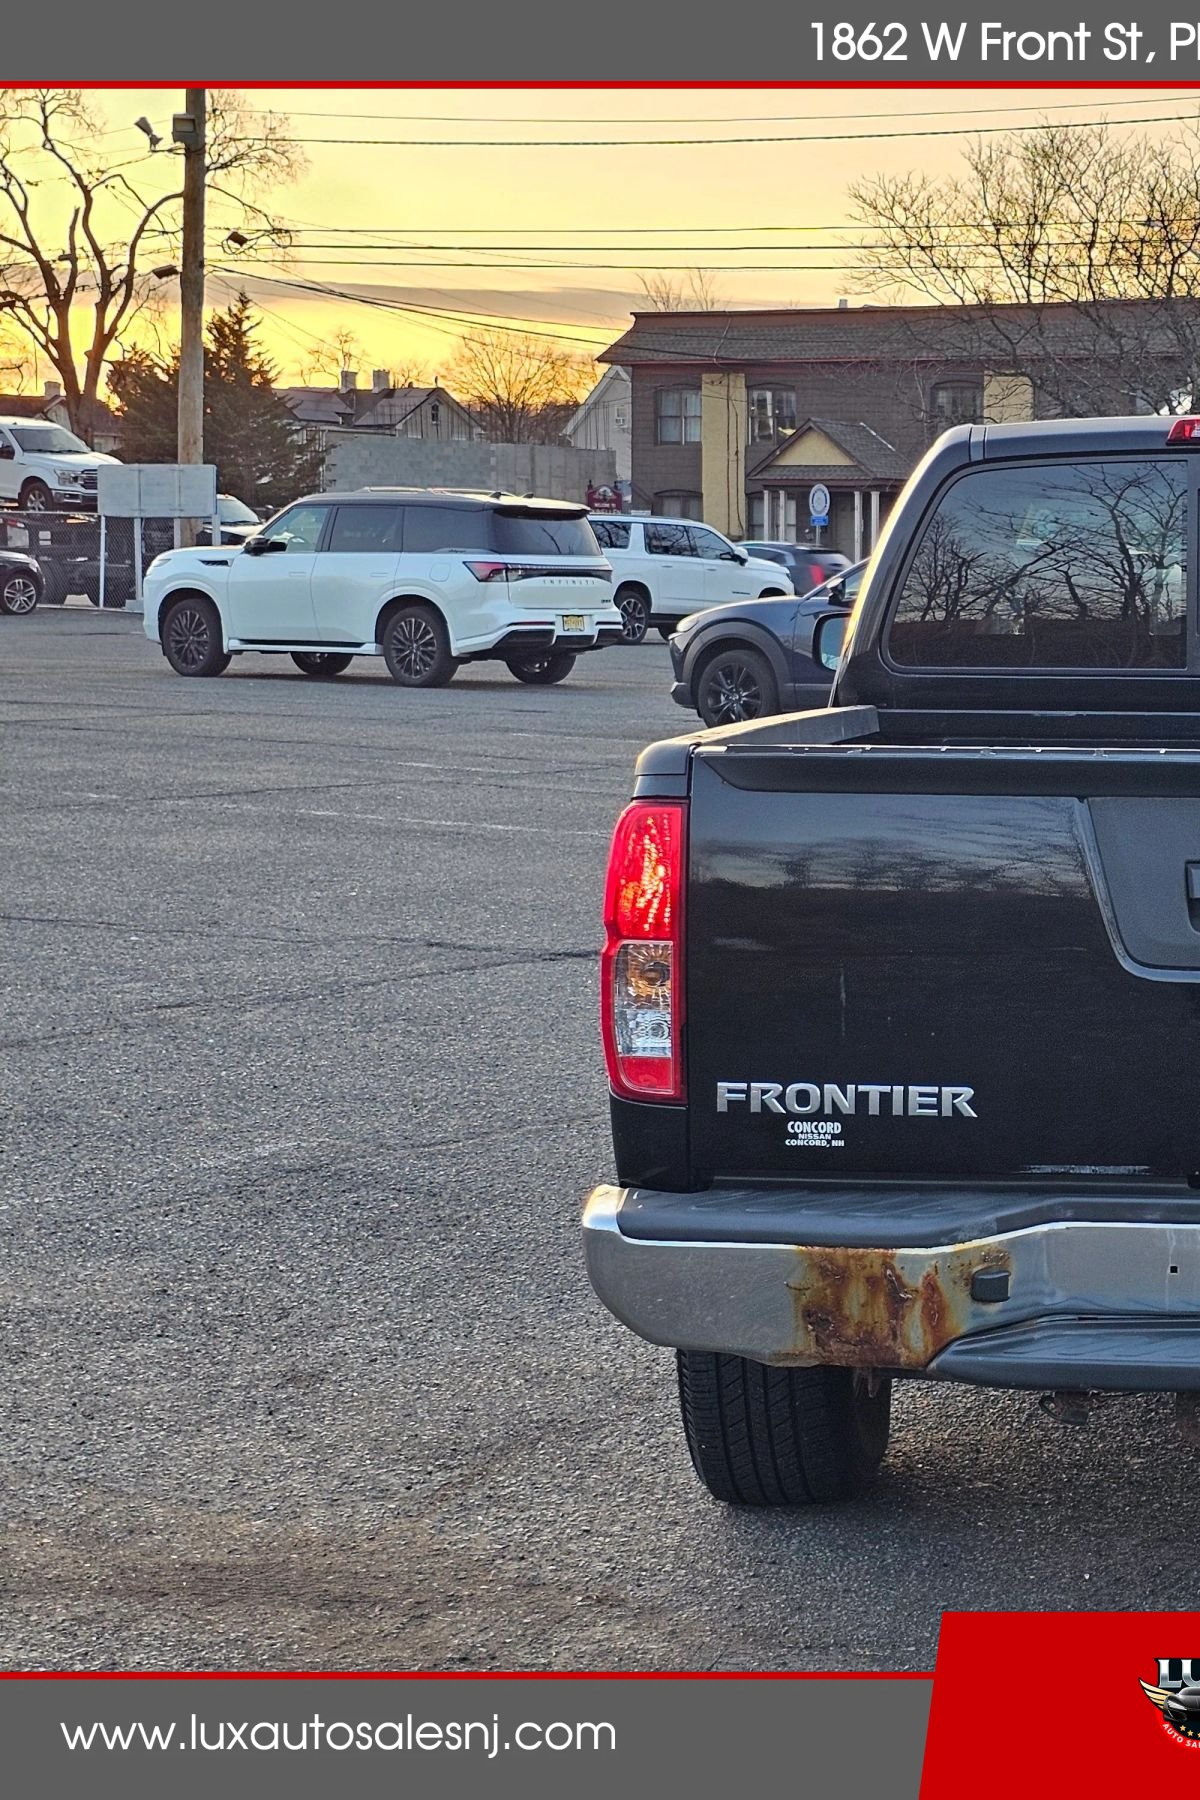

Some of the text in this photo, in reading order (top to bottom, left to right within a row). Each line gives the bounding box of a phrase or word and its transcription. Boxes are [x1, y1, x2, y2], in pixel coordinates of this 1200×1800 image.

[716, 1081, 978, 1117] FRONTIER
[787, 1121, 842, 1134] CONCORD
[785, 1139, 830, 1148] CONCORD,
